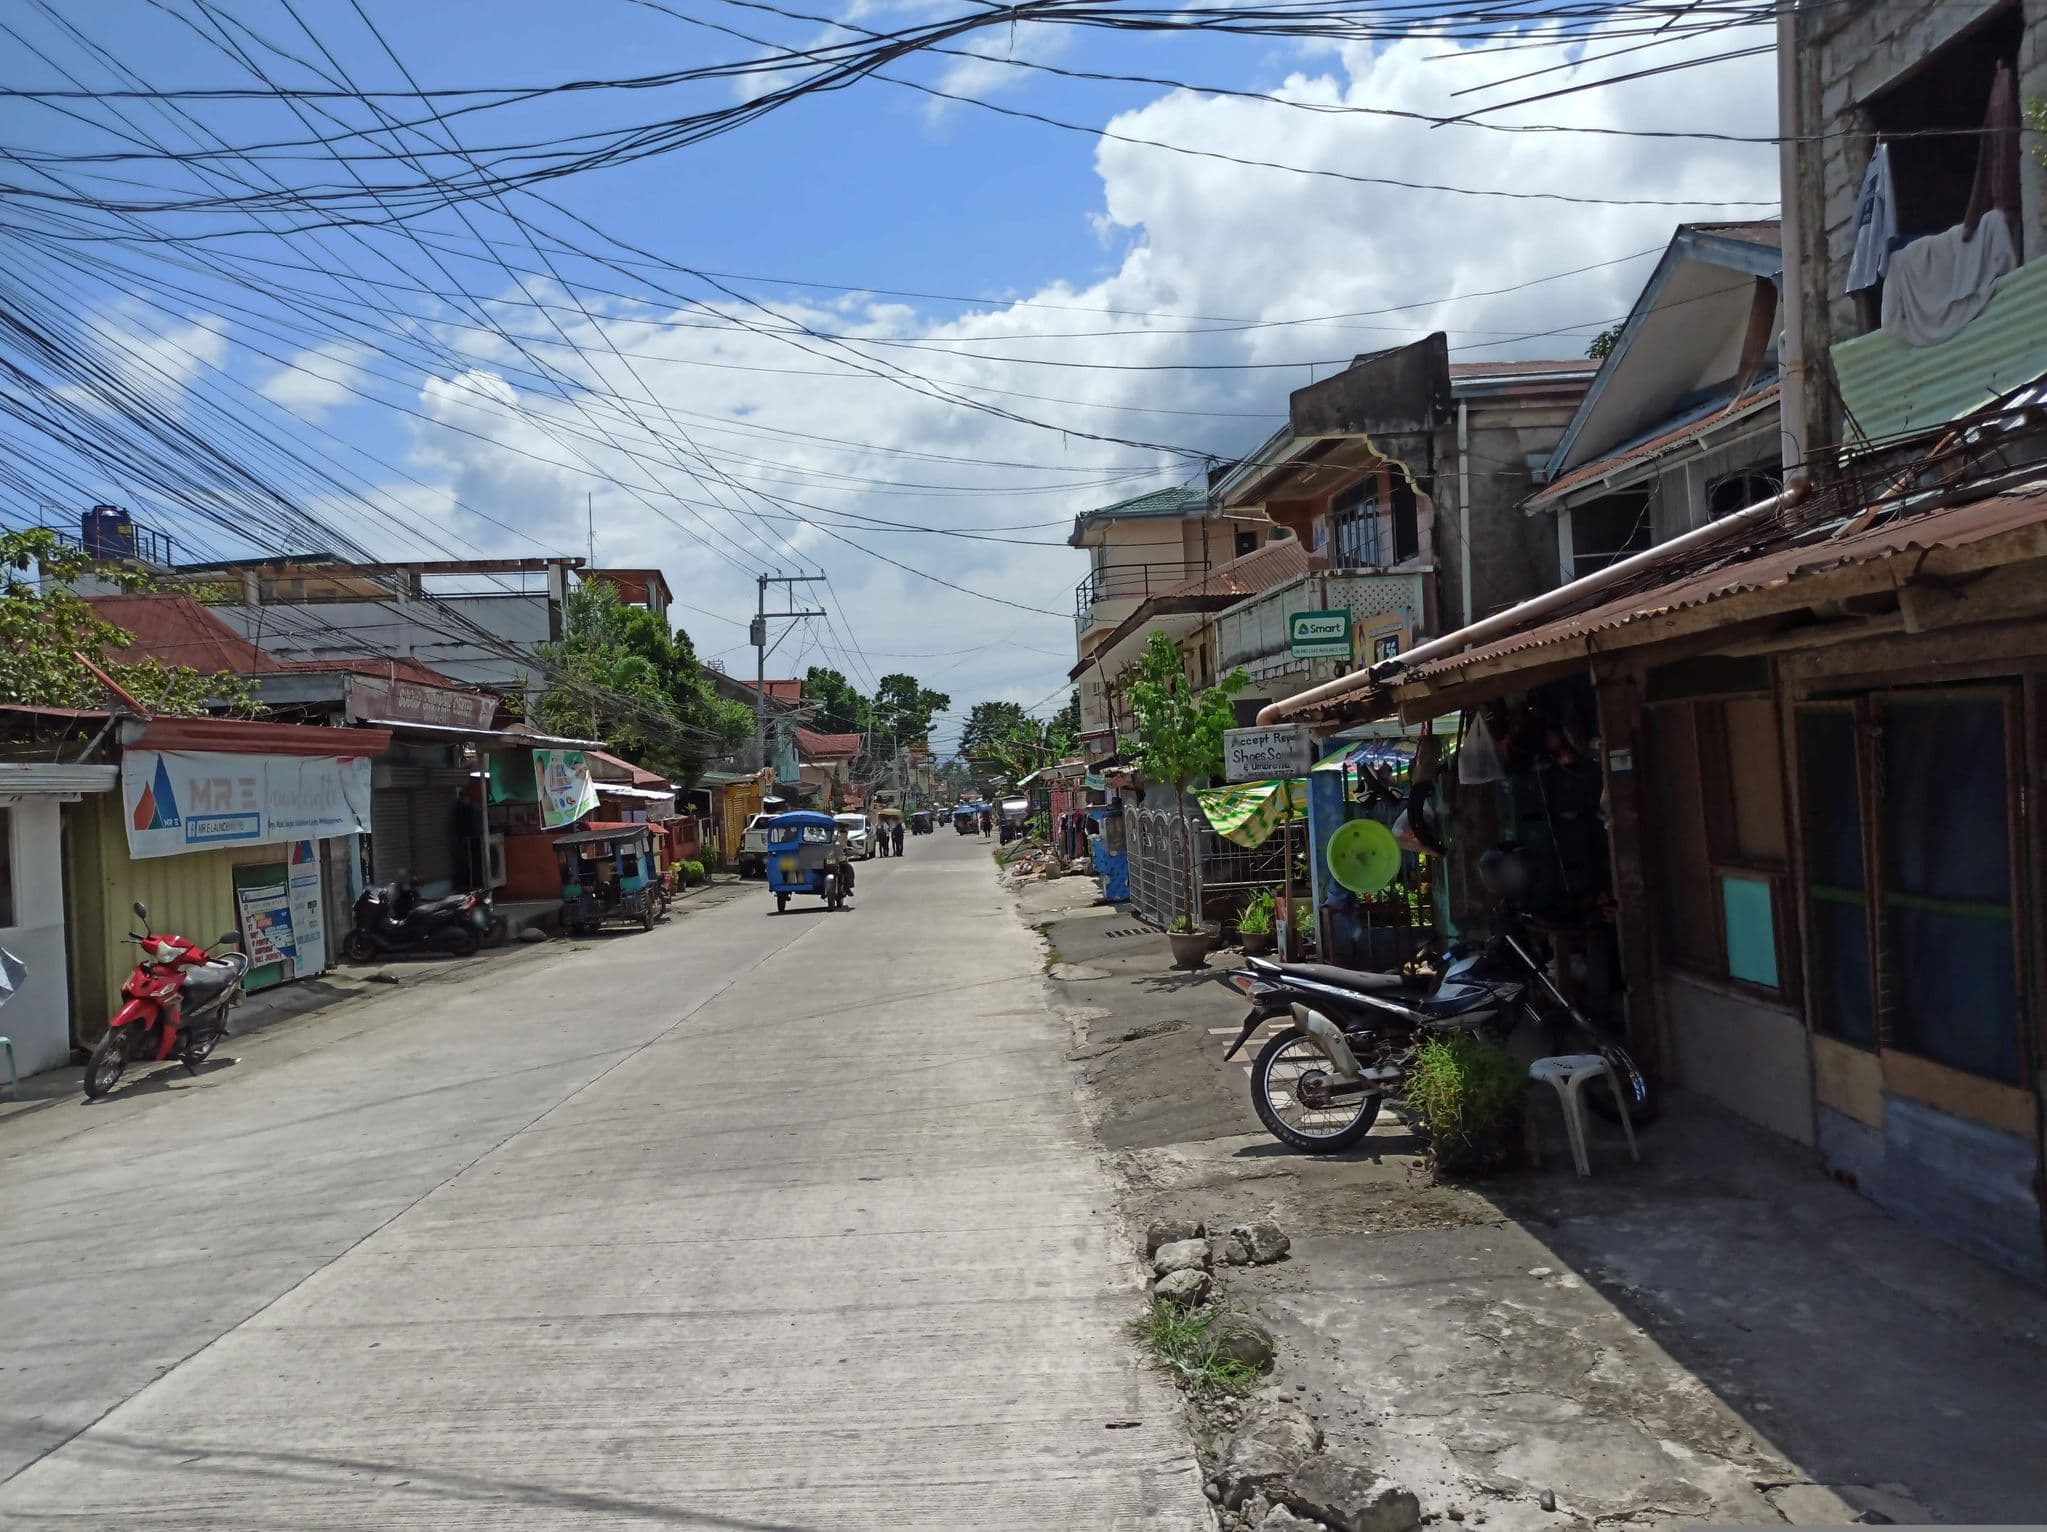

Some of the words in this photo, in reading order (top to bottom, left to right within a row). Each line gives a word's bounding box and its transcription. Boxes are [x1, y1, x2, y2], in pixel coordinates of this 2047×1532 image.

[1310, 623, 1341, 634] Smart
[1232, 749, 1266, 763] Shoes
[188, 777, 233, 811] MR
[238, 777, 257, 810] E
